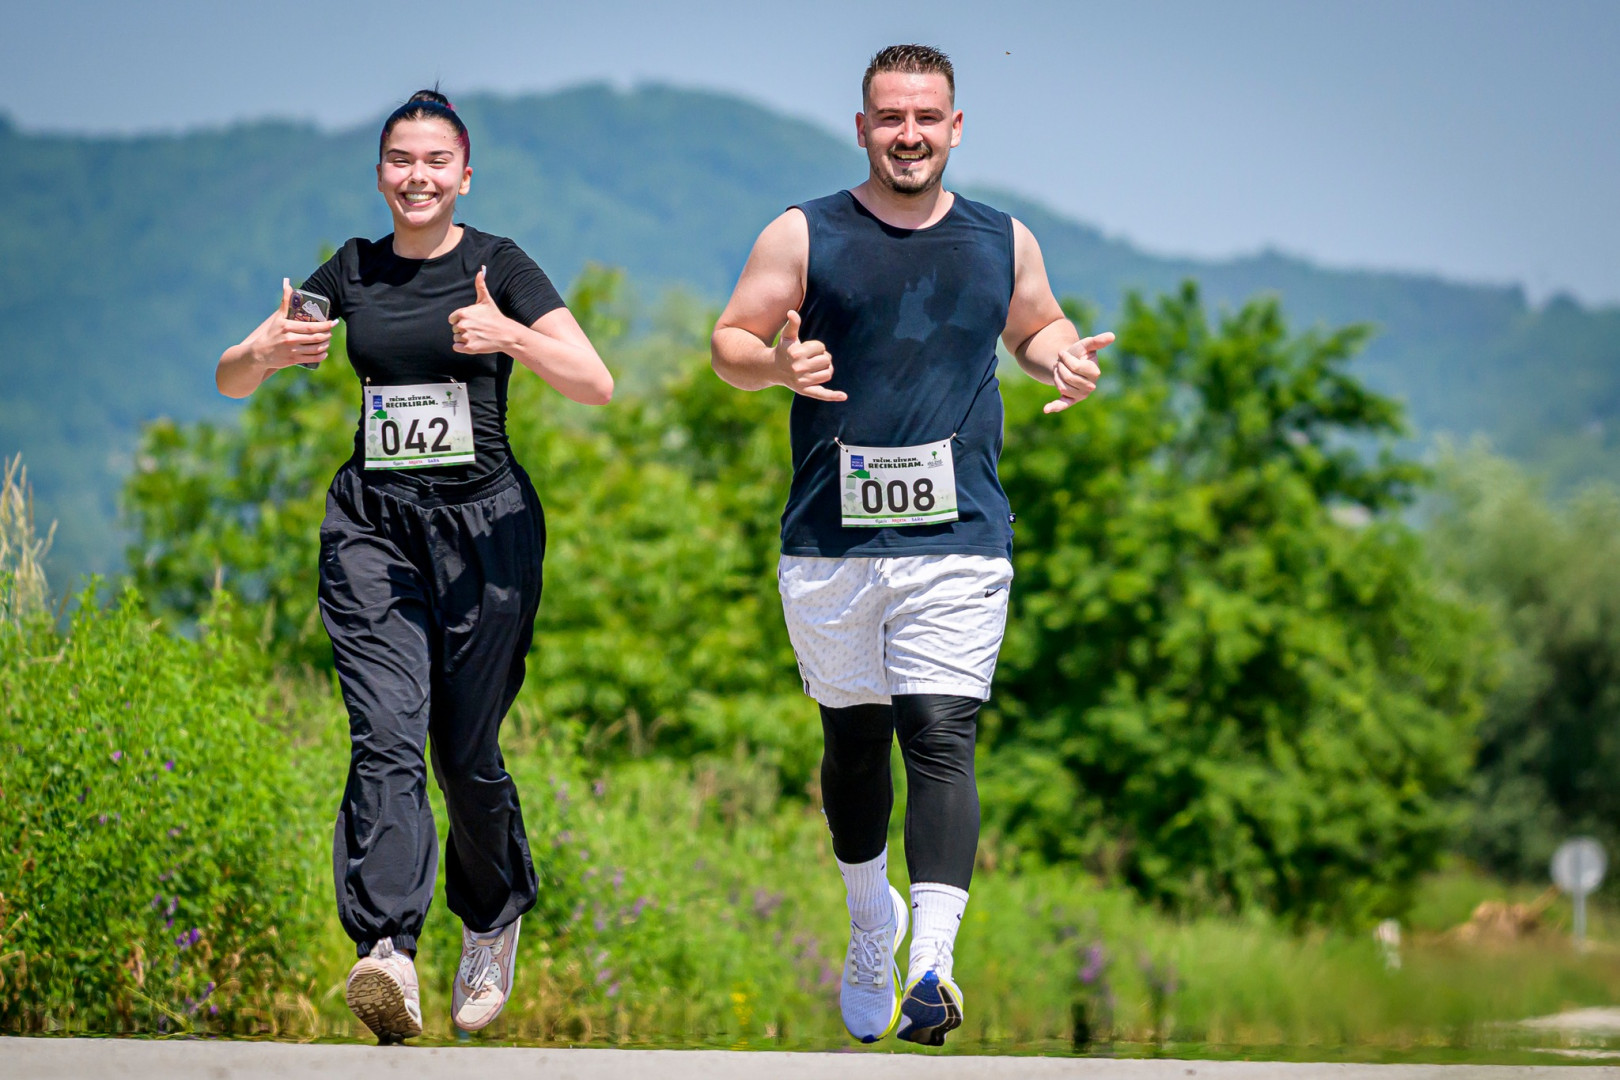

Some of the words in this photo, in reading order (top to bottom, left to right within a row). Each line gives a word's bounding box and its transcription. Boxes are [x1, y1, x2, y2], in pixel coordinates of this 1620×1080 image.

[386, 400, 438, 408] RECIKLIRAM.
[381, 417, 451, 456] 042
[861, 478, 935, 514] 008
